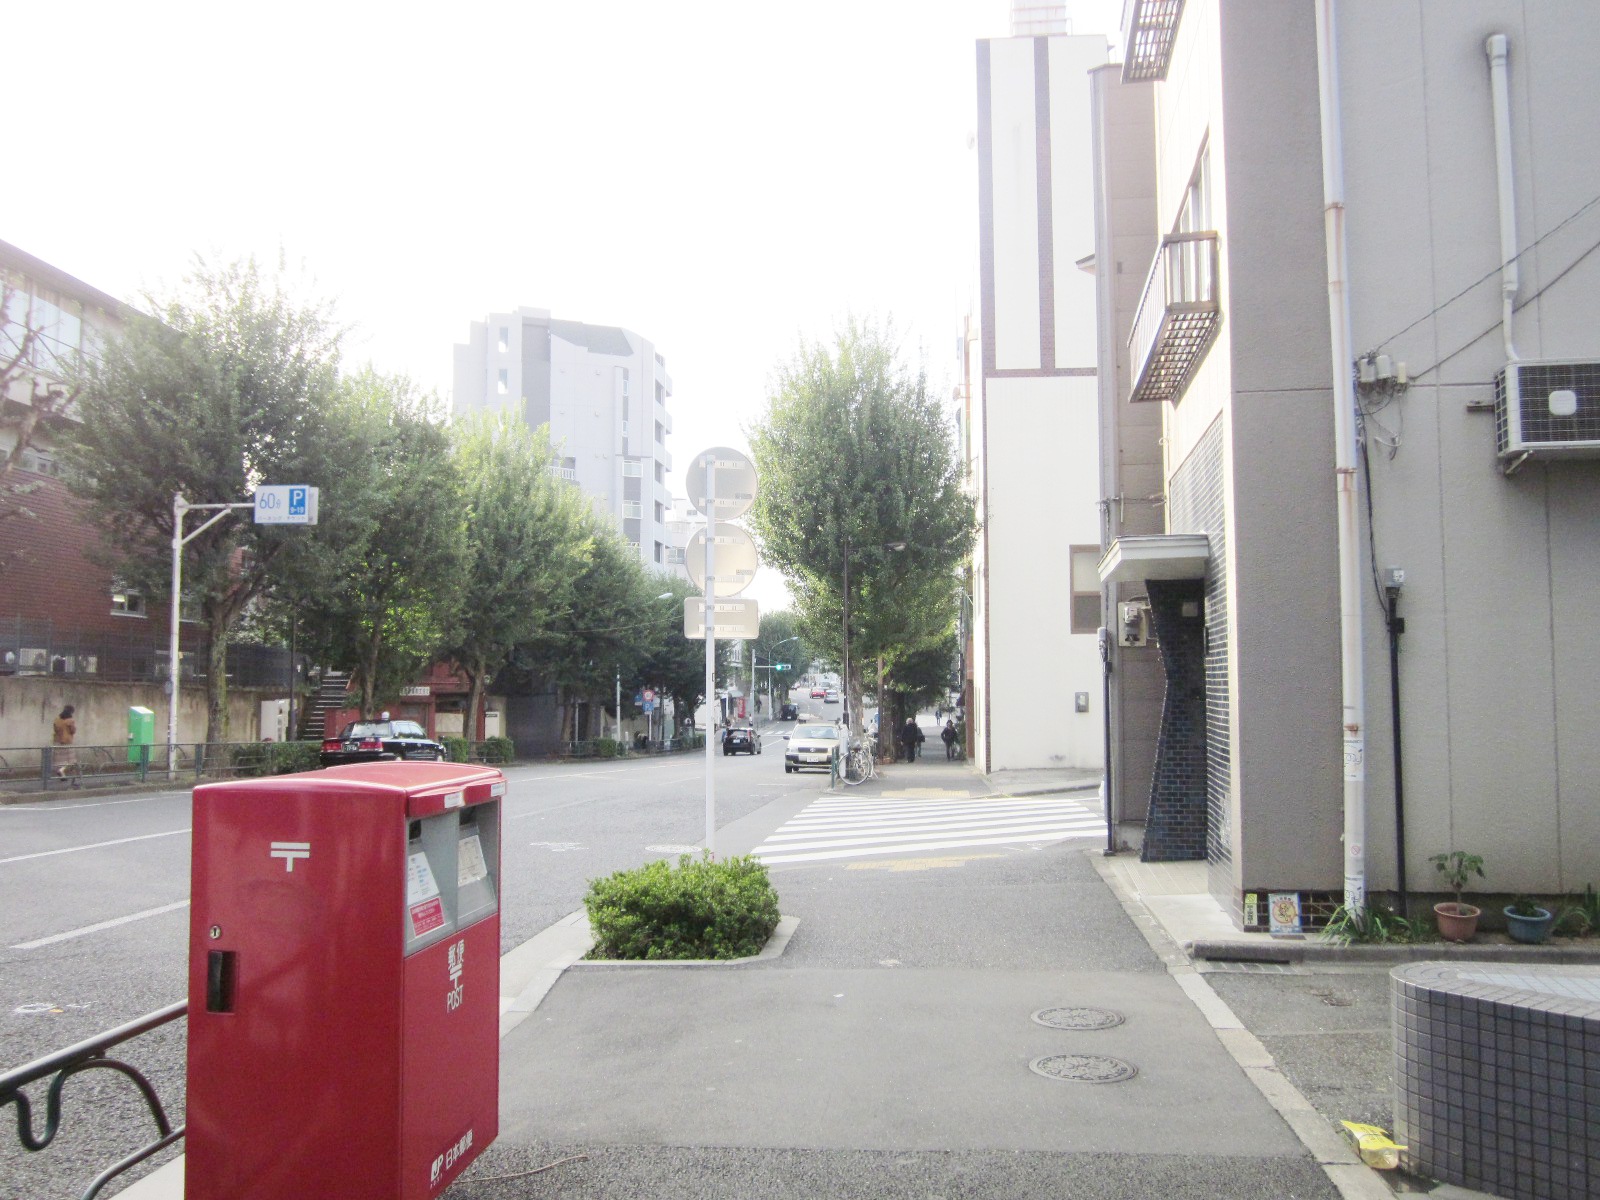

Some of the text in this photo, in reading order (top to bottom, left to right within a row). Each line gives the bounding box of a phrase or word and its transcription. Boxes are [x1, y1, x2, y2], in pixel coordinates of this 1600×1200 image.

[260, 492, 281, 509] 60分
[293, 490, 303, 506] P
[447, 984, 463, 1013] POST
[446, 1129, 473, 1169] 日本郵便
